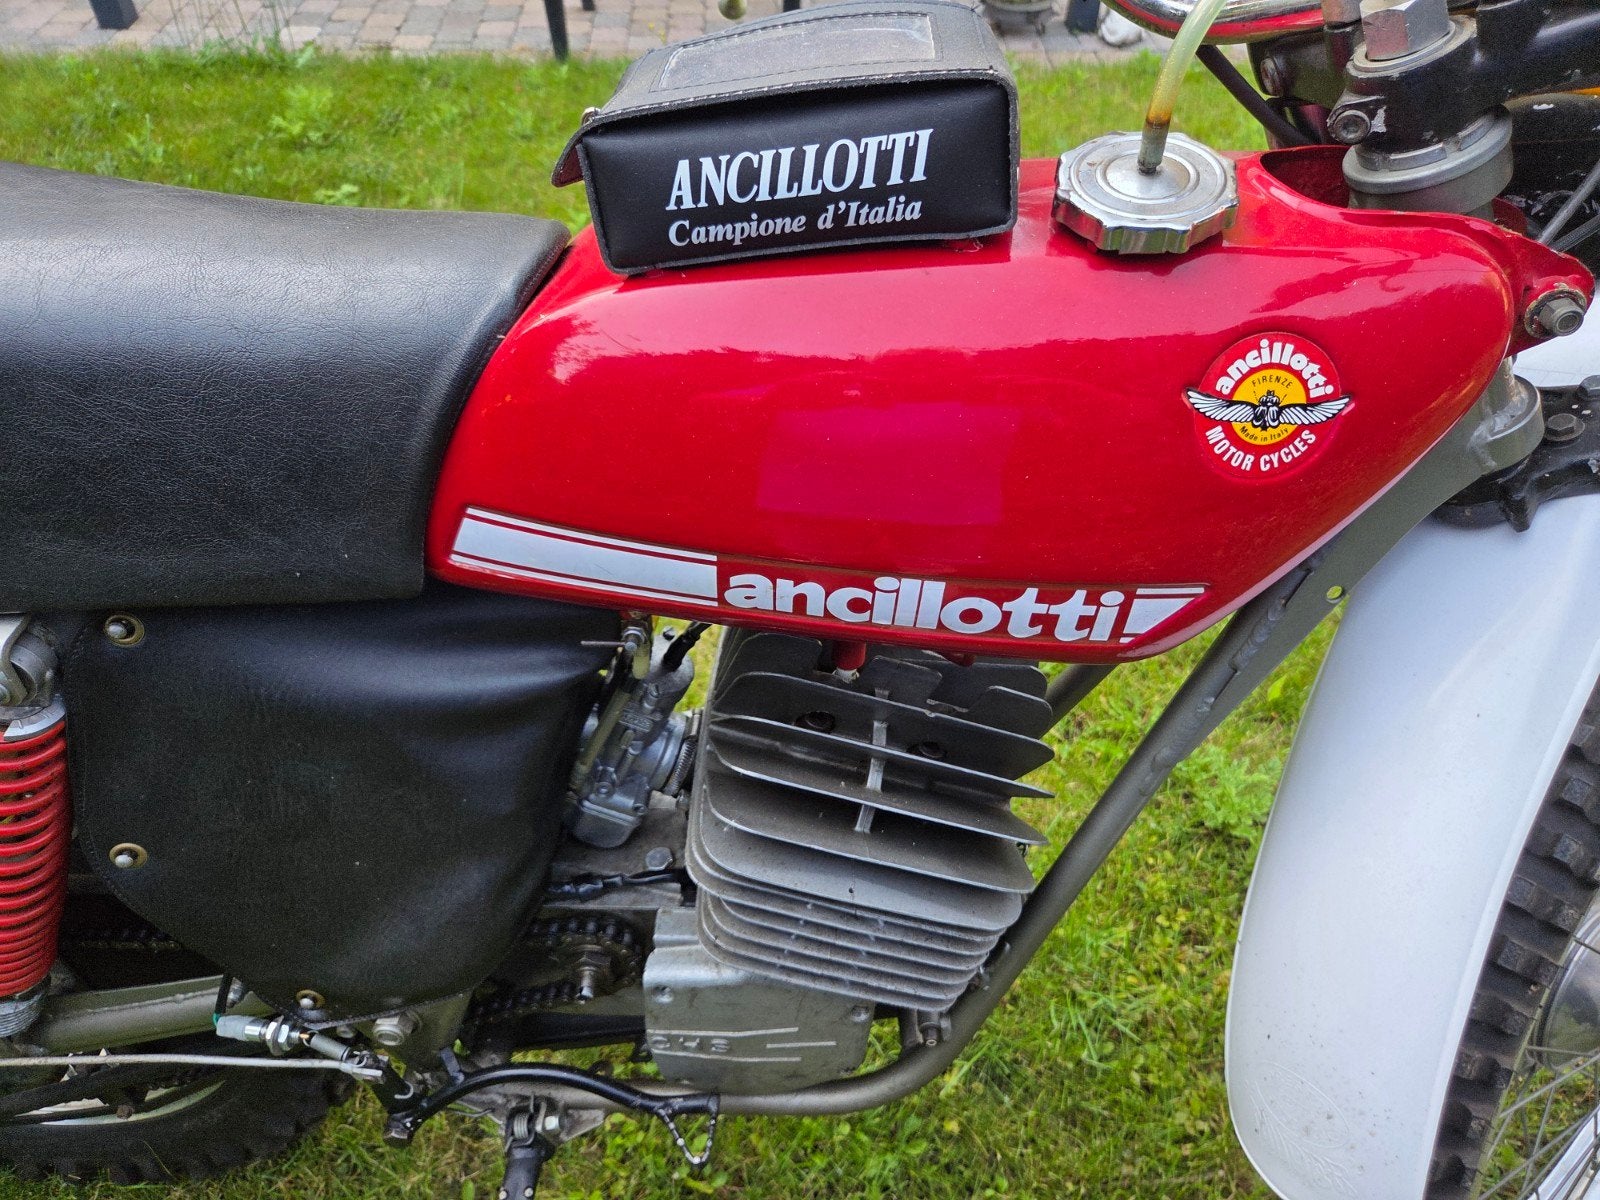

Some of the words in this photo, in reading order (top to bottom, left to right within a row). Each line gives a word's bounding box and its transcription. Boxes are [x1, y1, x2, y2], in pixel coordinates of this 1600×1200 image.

[666, 128, 933, 210] ANCILLOTTI
[668, 213, 807, 247] Campione
[817, 195, 923, 230] d'Italia
[1216, 339, 1334, 398] ancillotti
[1252, 375, 1293, 389] FIRENZE
[1206, 426, 1255, 471] MOTOR
[1260, 429, 1316, 472] CYCLES
[1240, 426, 1258, 440] Made
[1260, 434, 1268, 442] in
[1270, 427, 1289, 441] Italy
[724, 574, 1123, 641] ancillotti
